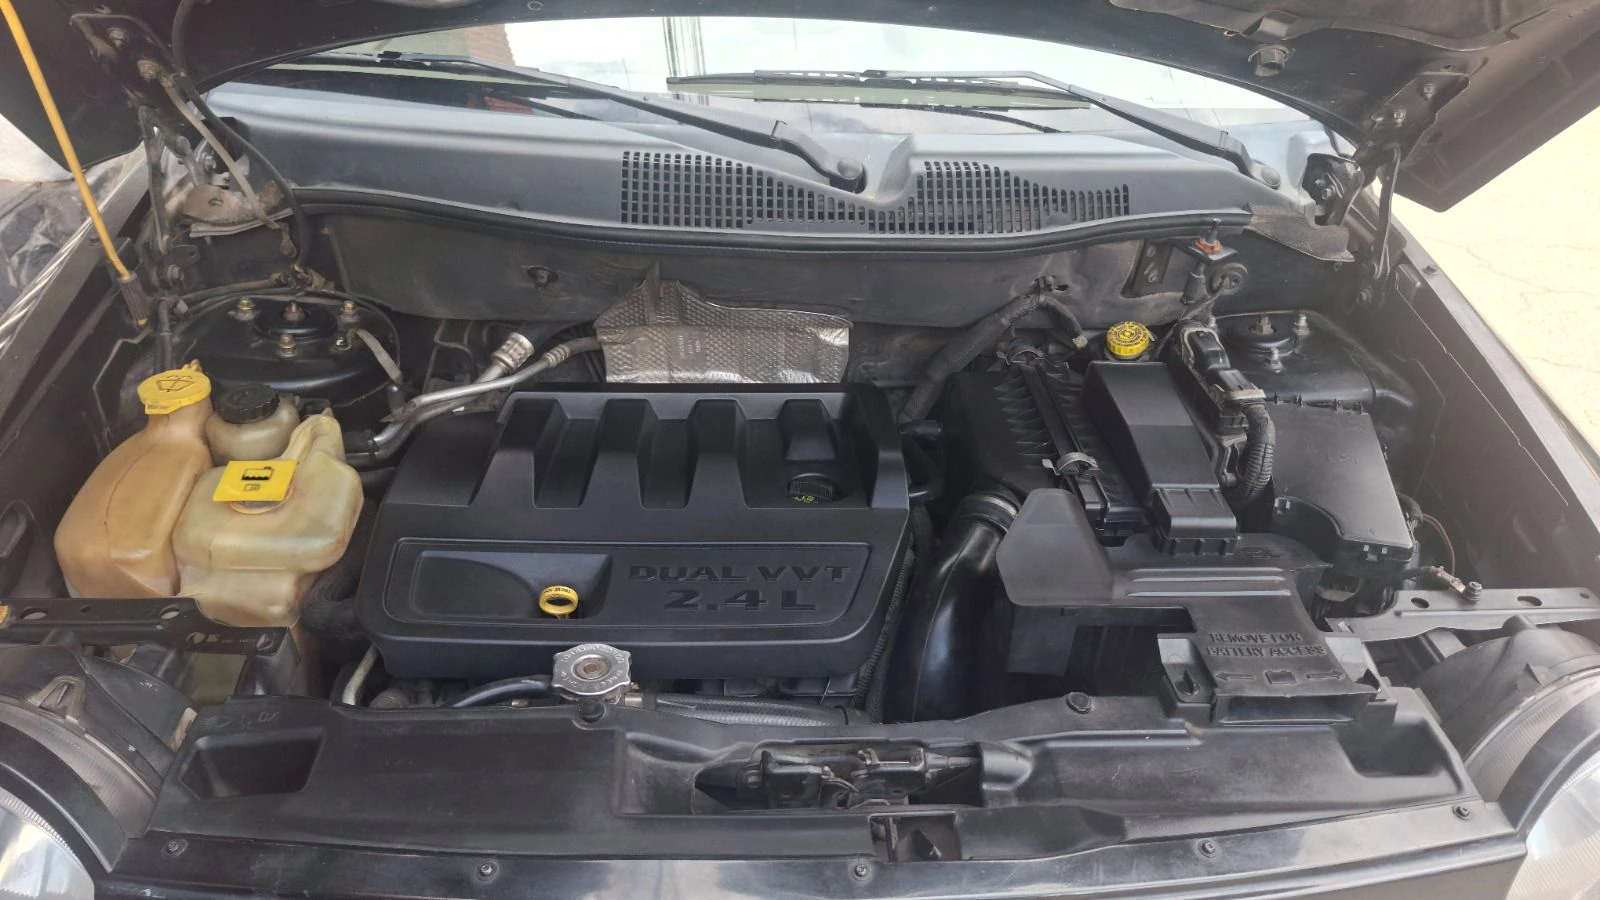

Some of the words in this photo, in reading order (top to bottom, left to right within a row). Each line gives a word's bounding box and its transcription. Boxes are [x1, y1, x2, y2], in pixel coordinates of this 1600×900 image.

[628, 565, 749, 582] DUAL
[757, 565, 850, 582] VVT
[1209, 632, 1269, 644] REMOVE
[1270, 632, 1302, 644] FOR
[1206, 645, 1265, 657] BATTERY
[1270, 645, 1328, 657] ACCESS
